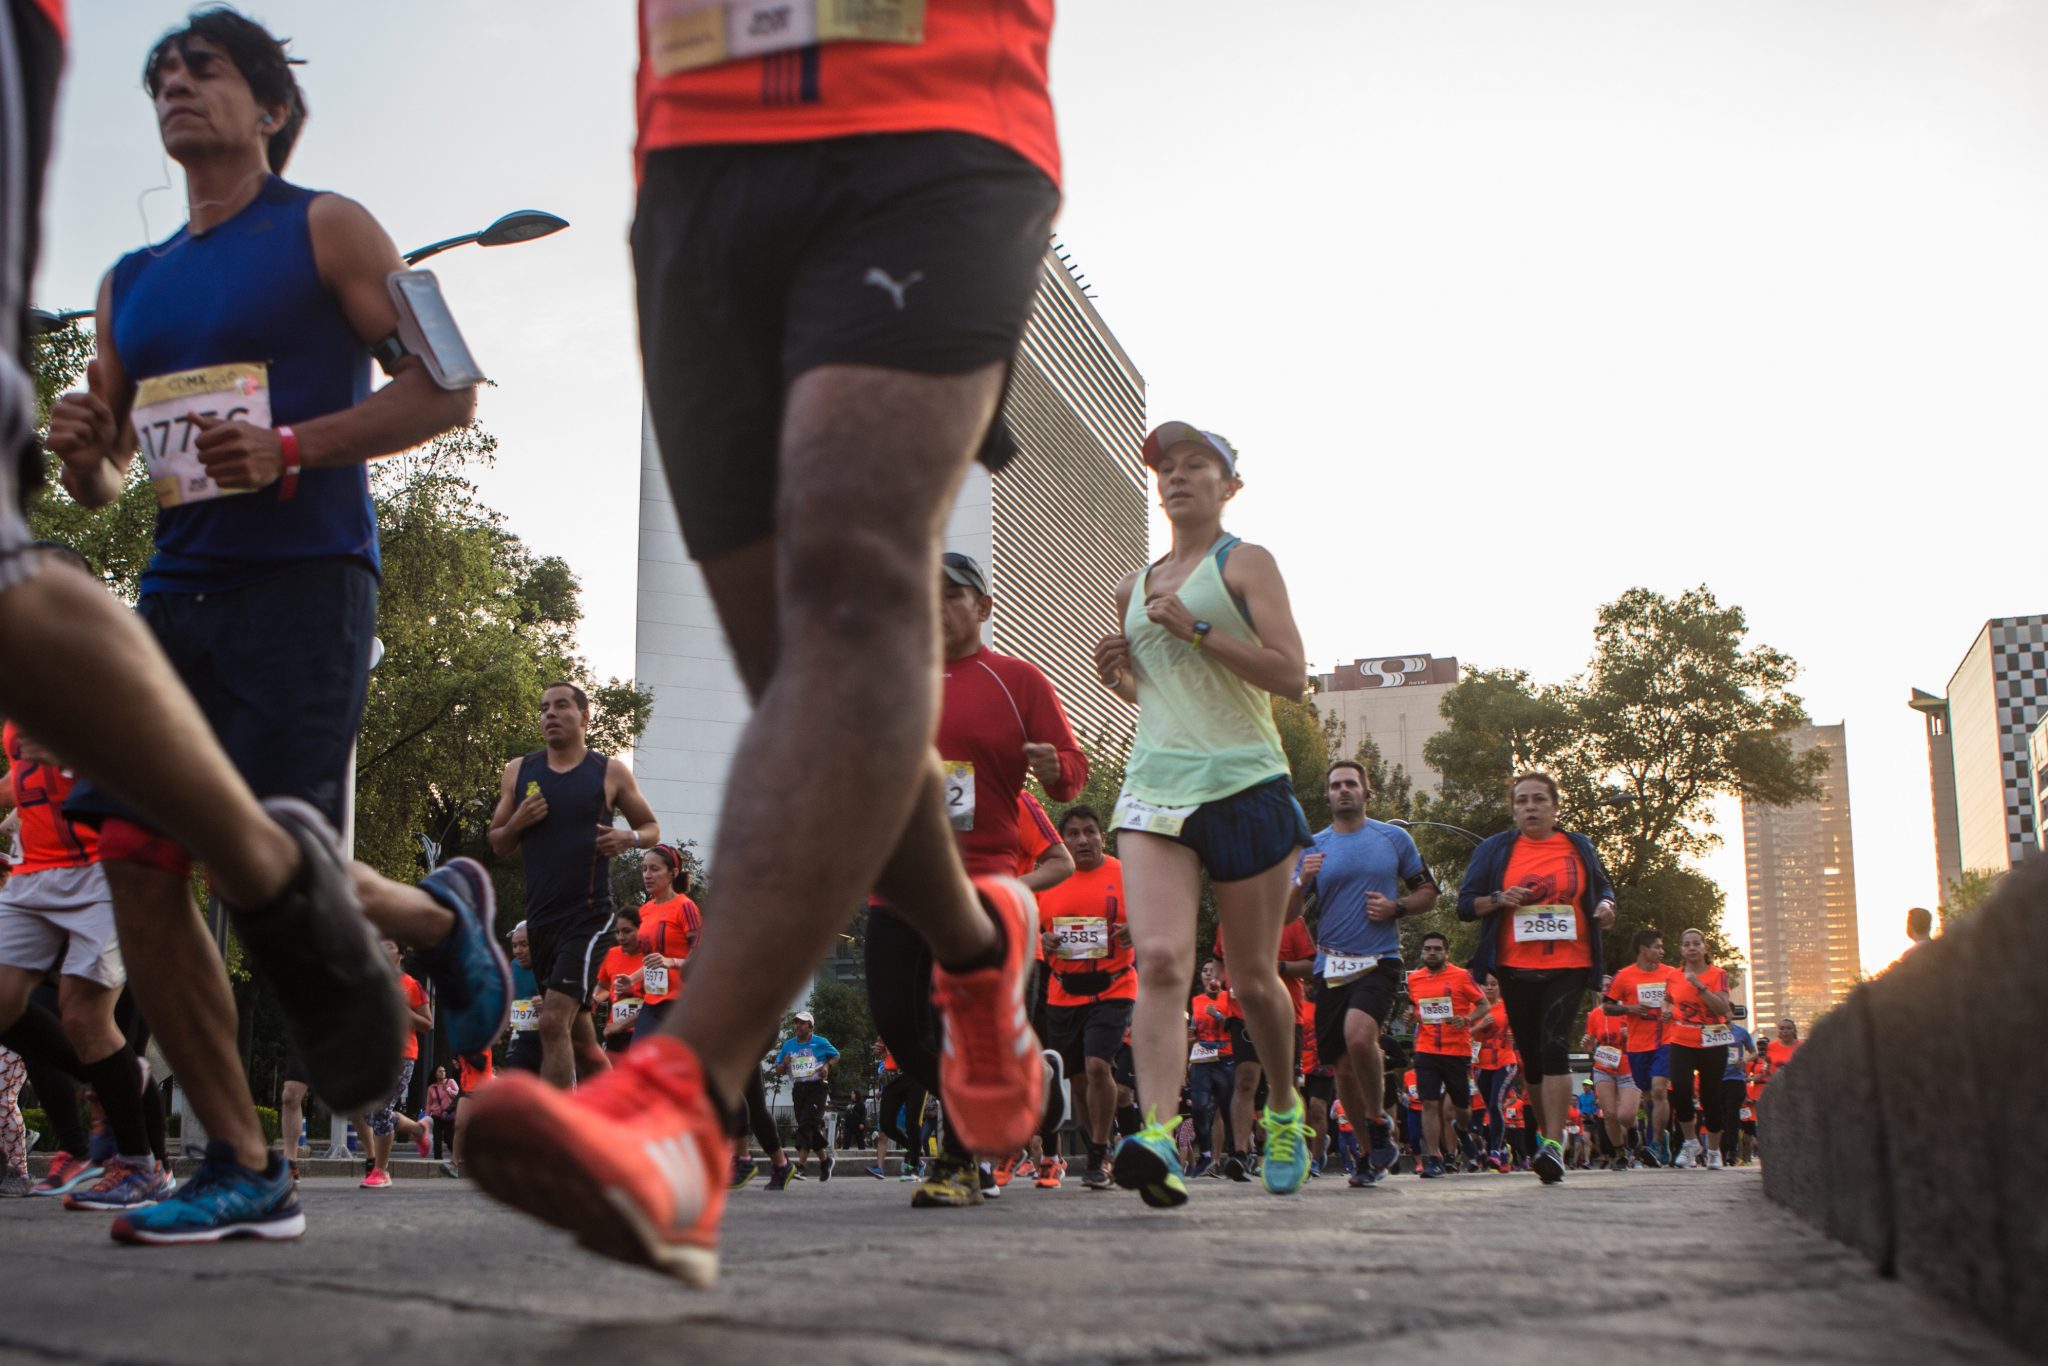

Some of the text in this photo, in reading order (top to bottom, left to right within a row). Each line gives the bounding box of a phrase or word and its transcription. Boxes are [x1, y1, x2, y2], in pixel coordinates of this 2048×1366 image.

[142, 406, 249, 461] 177
[1523, 919, 1569, 934] 2886
[1060, 930, 1099, 944] 3585
[512, 1009, 540, 1020] 17974
[615, 1007, 640, 1018] 145
[1422, 1004, 1450, 1015] 18289
